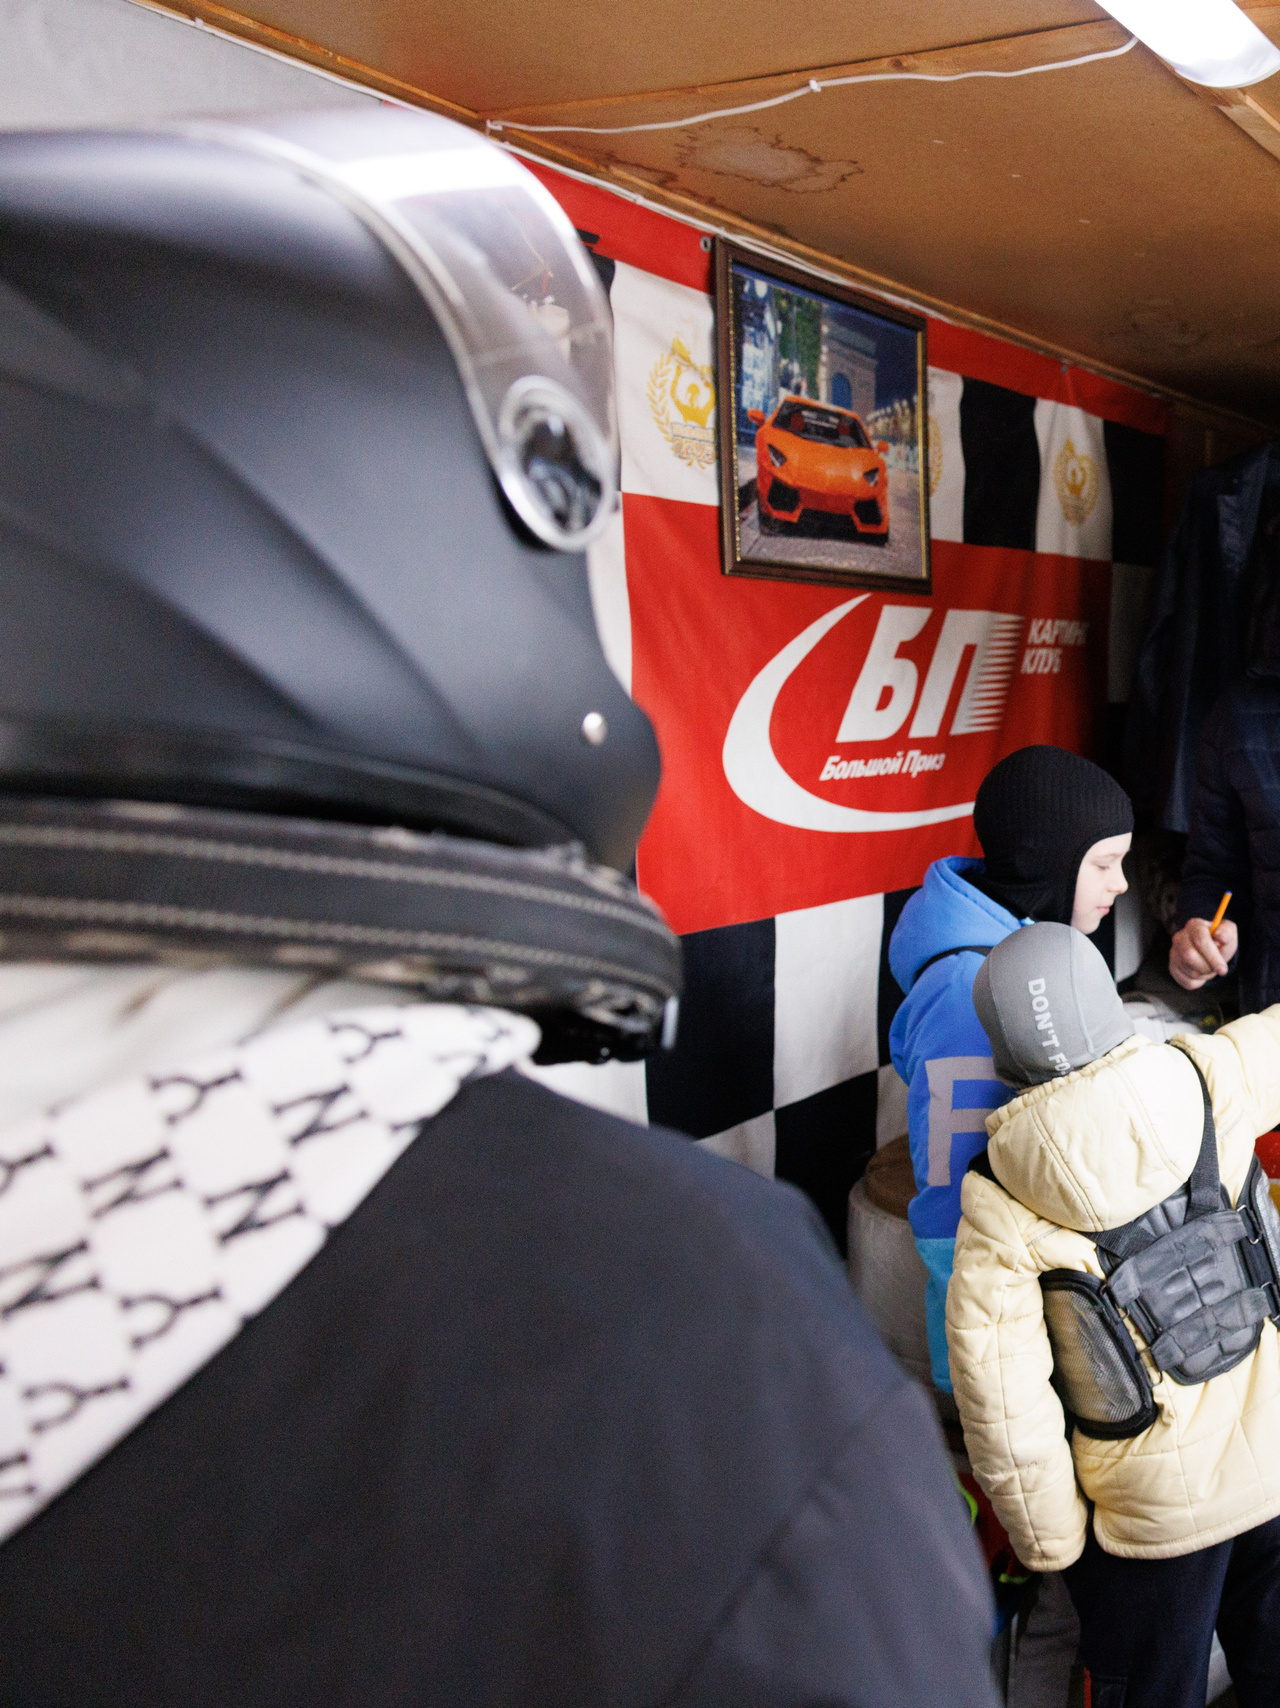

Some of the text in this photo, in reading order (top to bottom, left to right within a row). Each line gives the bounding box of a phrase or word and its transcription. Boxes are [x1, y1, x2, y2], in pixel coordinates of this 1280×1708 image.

[835, 604, 1024, 743] БП
[1020, 647, 1062, 674] КЛУБ
[819, 749, 946, 781] Большой Приз
[1028, 978, 1060, 1048] DON'T
